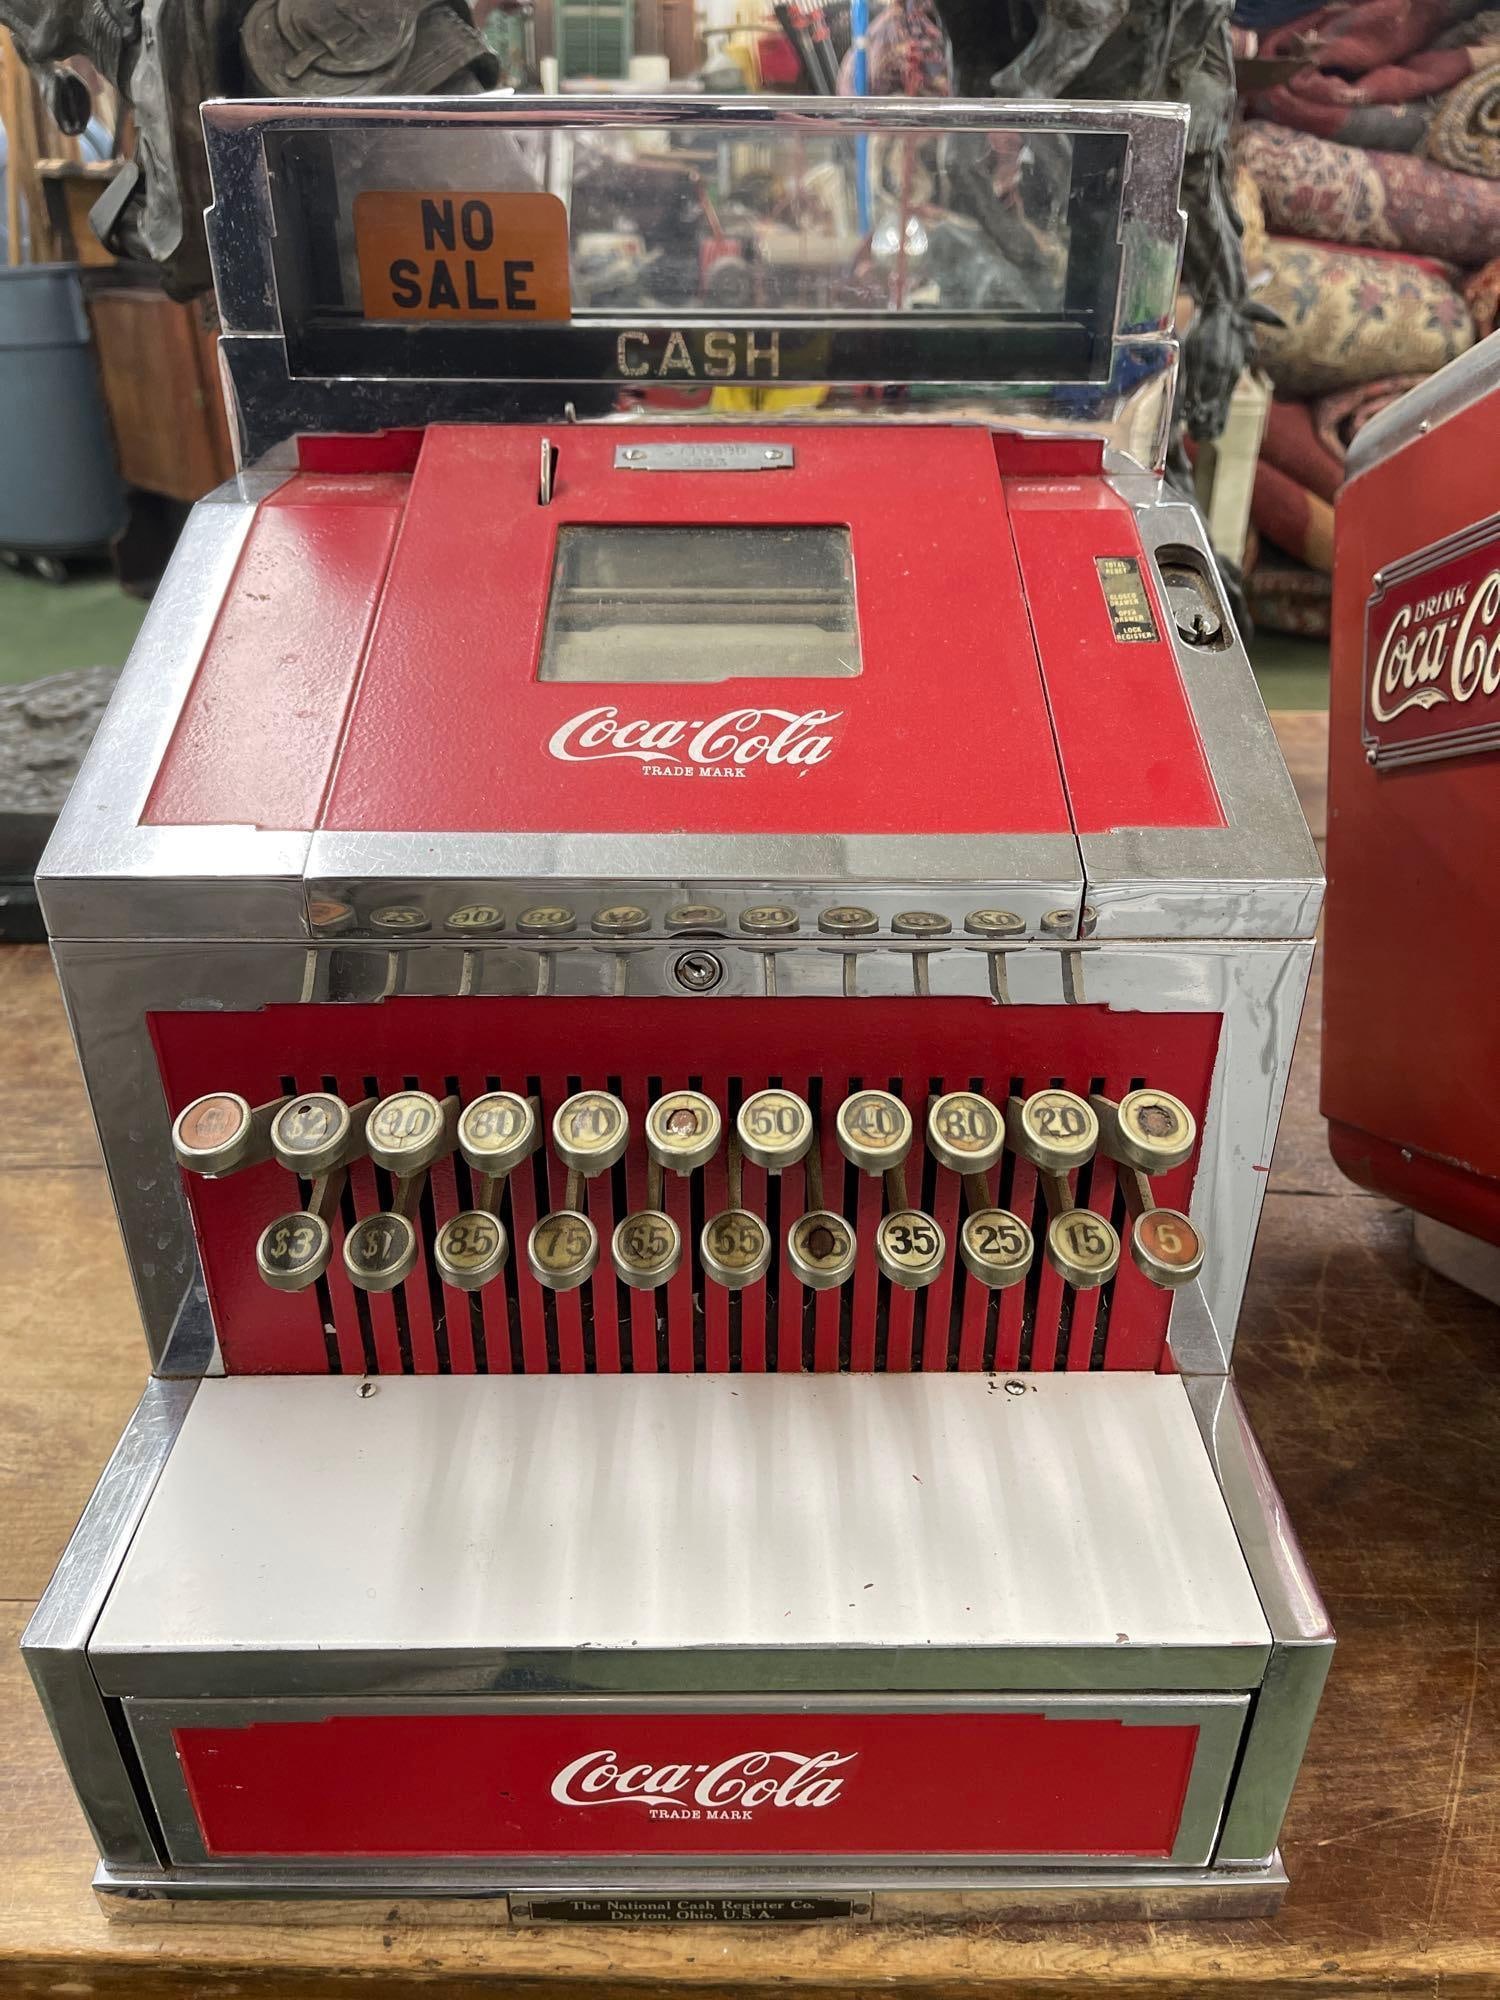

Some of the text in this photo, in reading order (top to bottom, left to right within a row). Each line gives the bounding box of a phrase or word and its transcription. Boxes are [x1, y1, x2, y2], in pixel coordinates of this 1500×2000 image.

[421, 199, 494, 251] NO
[389, 259, 537, 311] SALE
[616, 330, 780, 378] CASH
[1414, 583, 1470, 622] DRINK
[1116, 632, 1151, 640] REGISTER
[548, 706, 844, 765] Coca-Cola
[642, 765, 746, 778] TRADE MARK
[378, 1107, 431, 1137] 90
[751, 1107, 798, 1136] 50
[1034, 1107, 1086, 1138] 20
[446, 1225, 494, 1255] 85
[543, 1227, 588, 1257] 75
[623, 1226, 669, 1257] 65
[714, 1226, 761, 1256] 55
[889, 1226, 937, 1255] 35
[975, 1226, 1023, 1255] 25
[1067, 1225, 1106, 1255] 15
[1157, 1224, 1183, 1254] 5
[551, 1750, 858, 1807] Coca-Cola
[649, 1809, 753, 1820] TRADE MARK
[570, 1900, 815, 1912] The National Cash Register Co.
[611, 1911, 672, 1922] Dayton,
[676, 1911, 718, 1921] Ohio,
